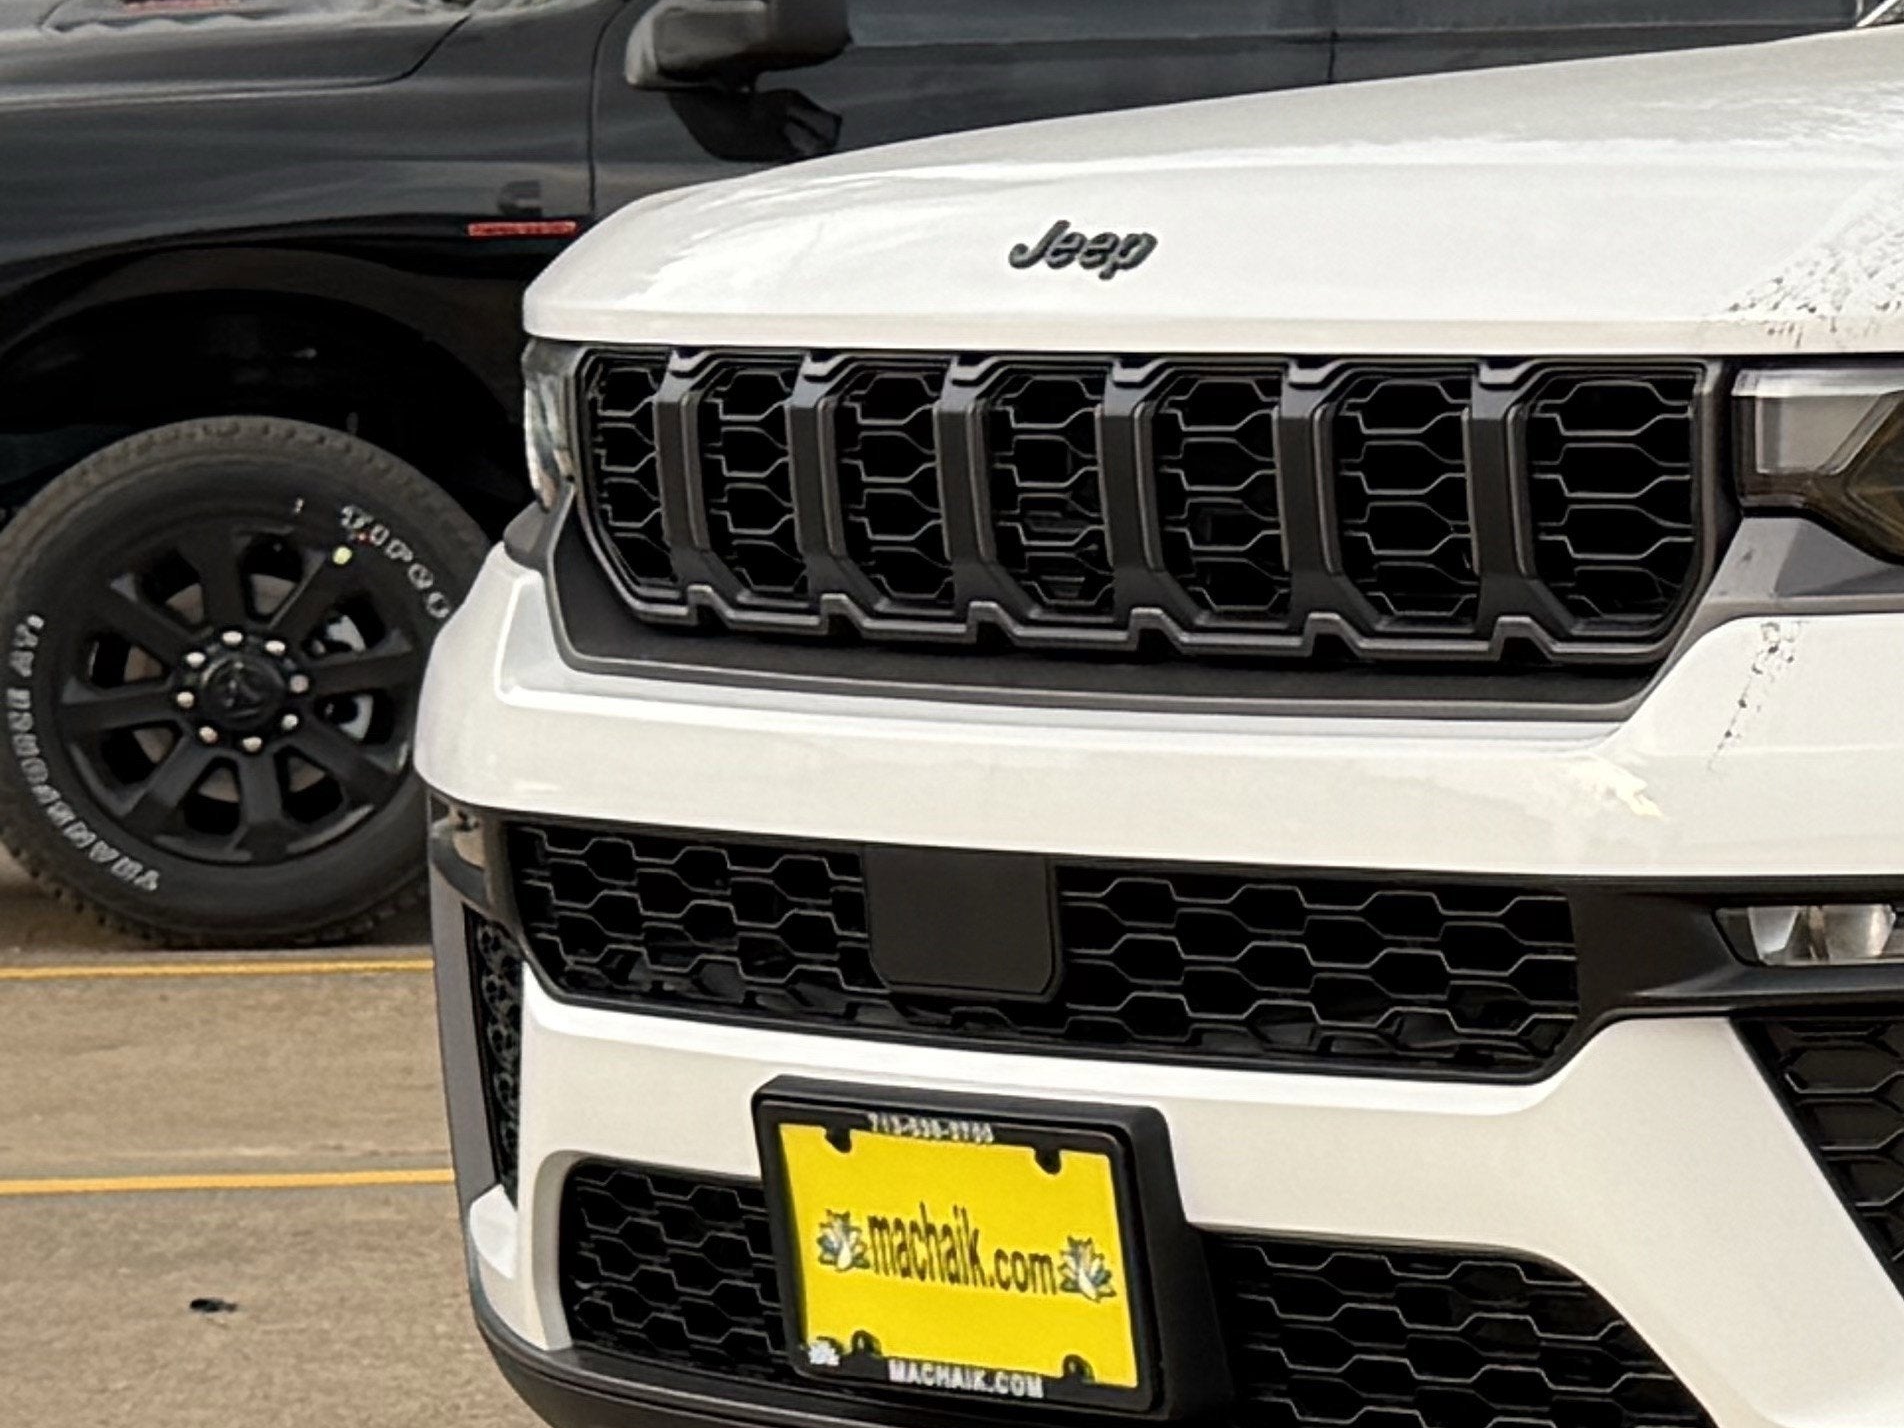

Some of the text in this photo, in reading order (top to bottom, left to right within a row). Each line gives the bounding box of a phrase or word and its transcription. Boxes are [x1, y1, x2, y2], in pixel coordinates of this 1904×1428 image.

[1008, 219, 1158, 280] Jeep
[867, 1200, 1058, 1295] machaik.com
[888, 1358, 1044, 1399] MACHAIK.COM
